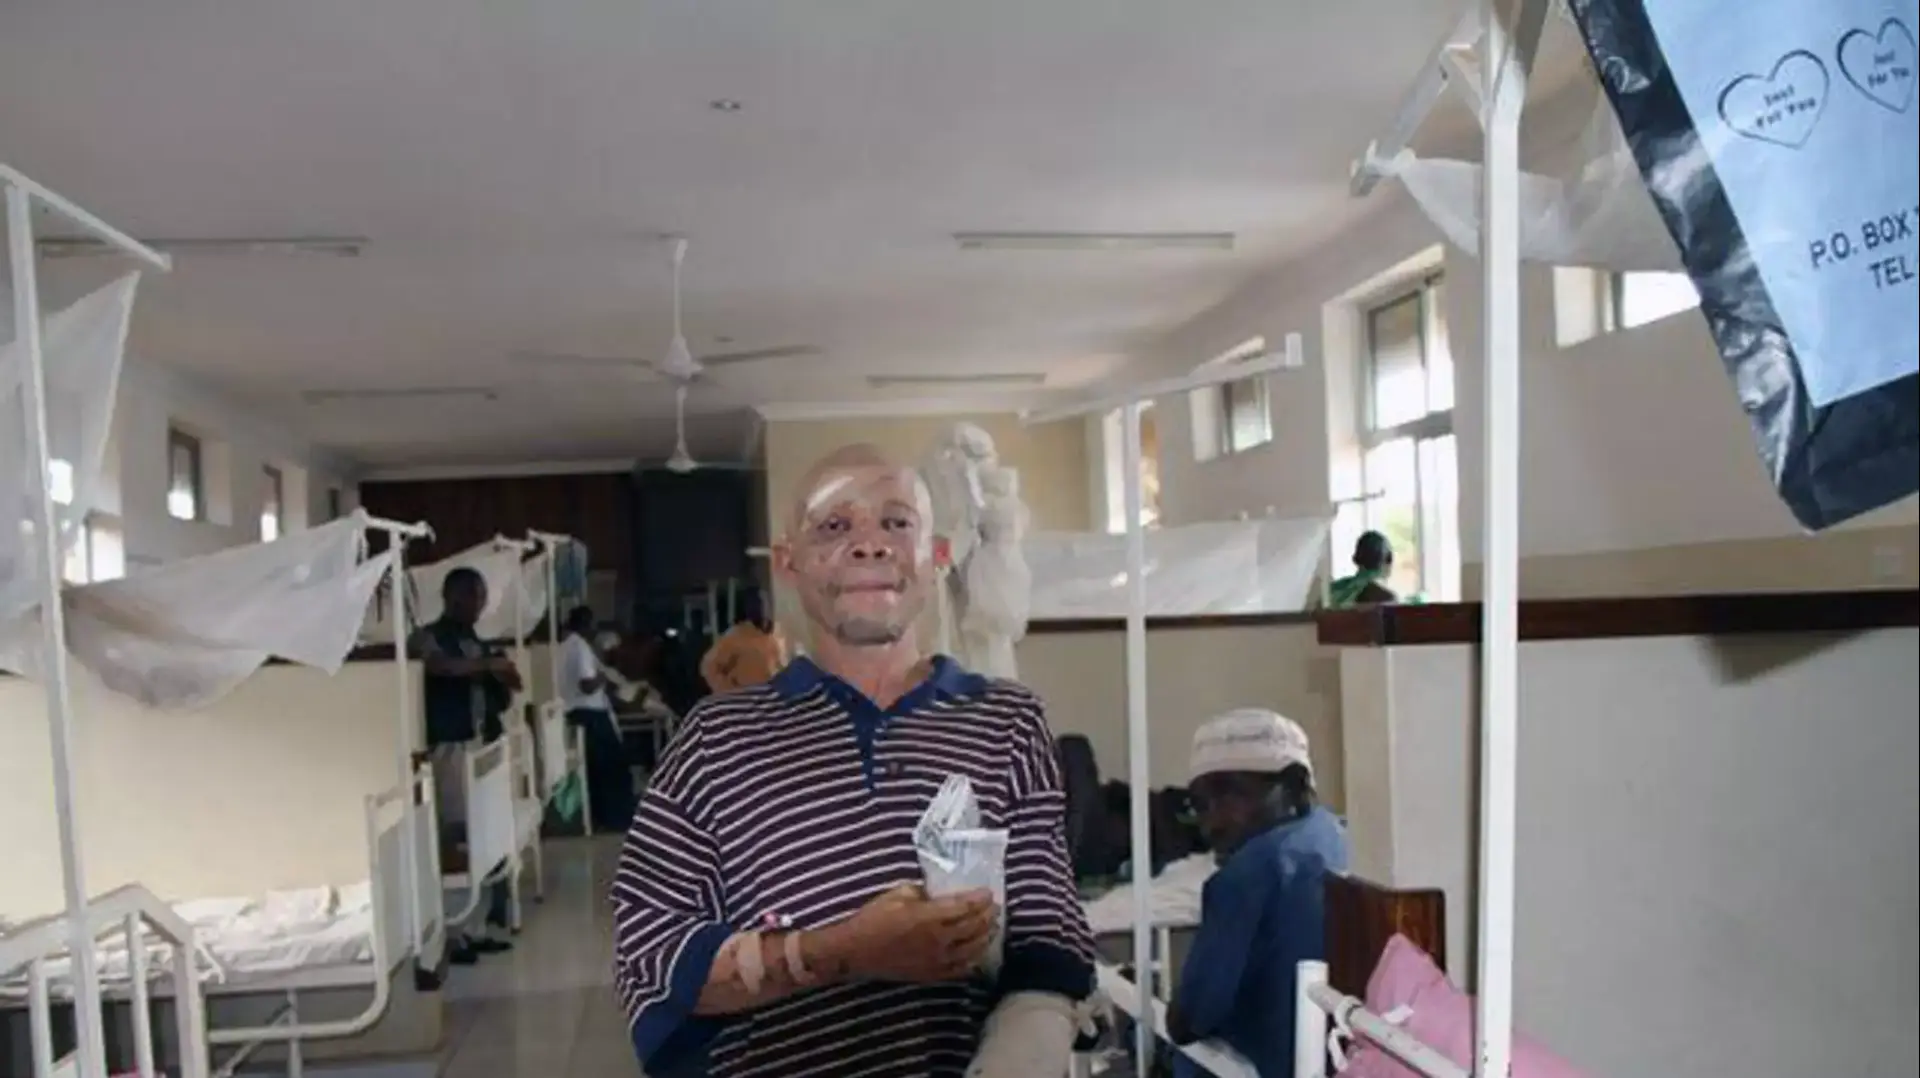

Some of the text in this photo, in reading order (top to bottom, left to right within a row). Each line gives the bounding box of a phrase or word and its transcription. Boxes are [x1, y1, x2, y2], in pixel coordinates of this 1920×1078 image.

[1809, 209, 1912, 269] P.O. BOX
[1867, 256, 1915, 290] TEL
